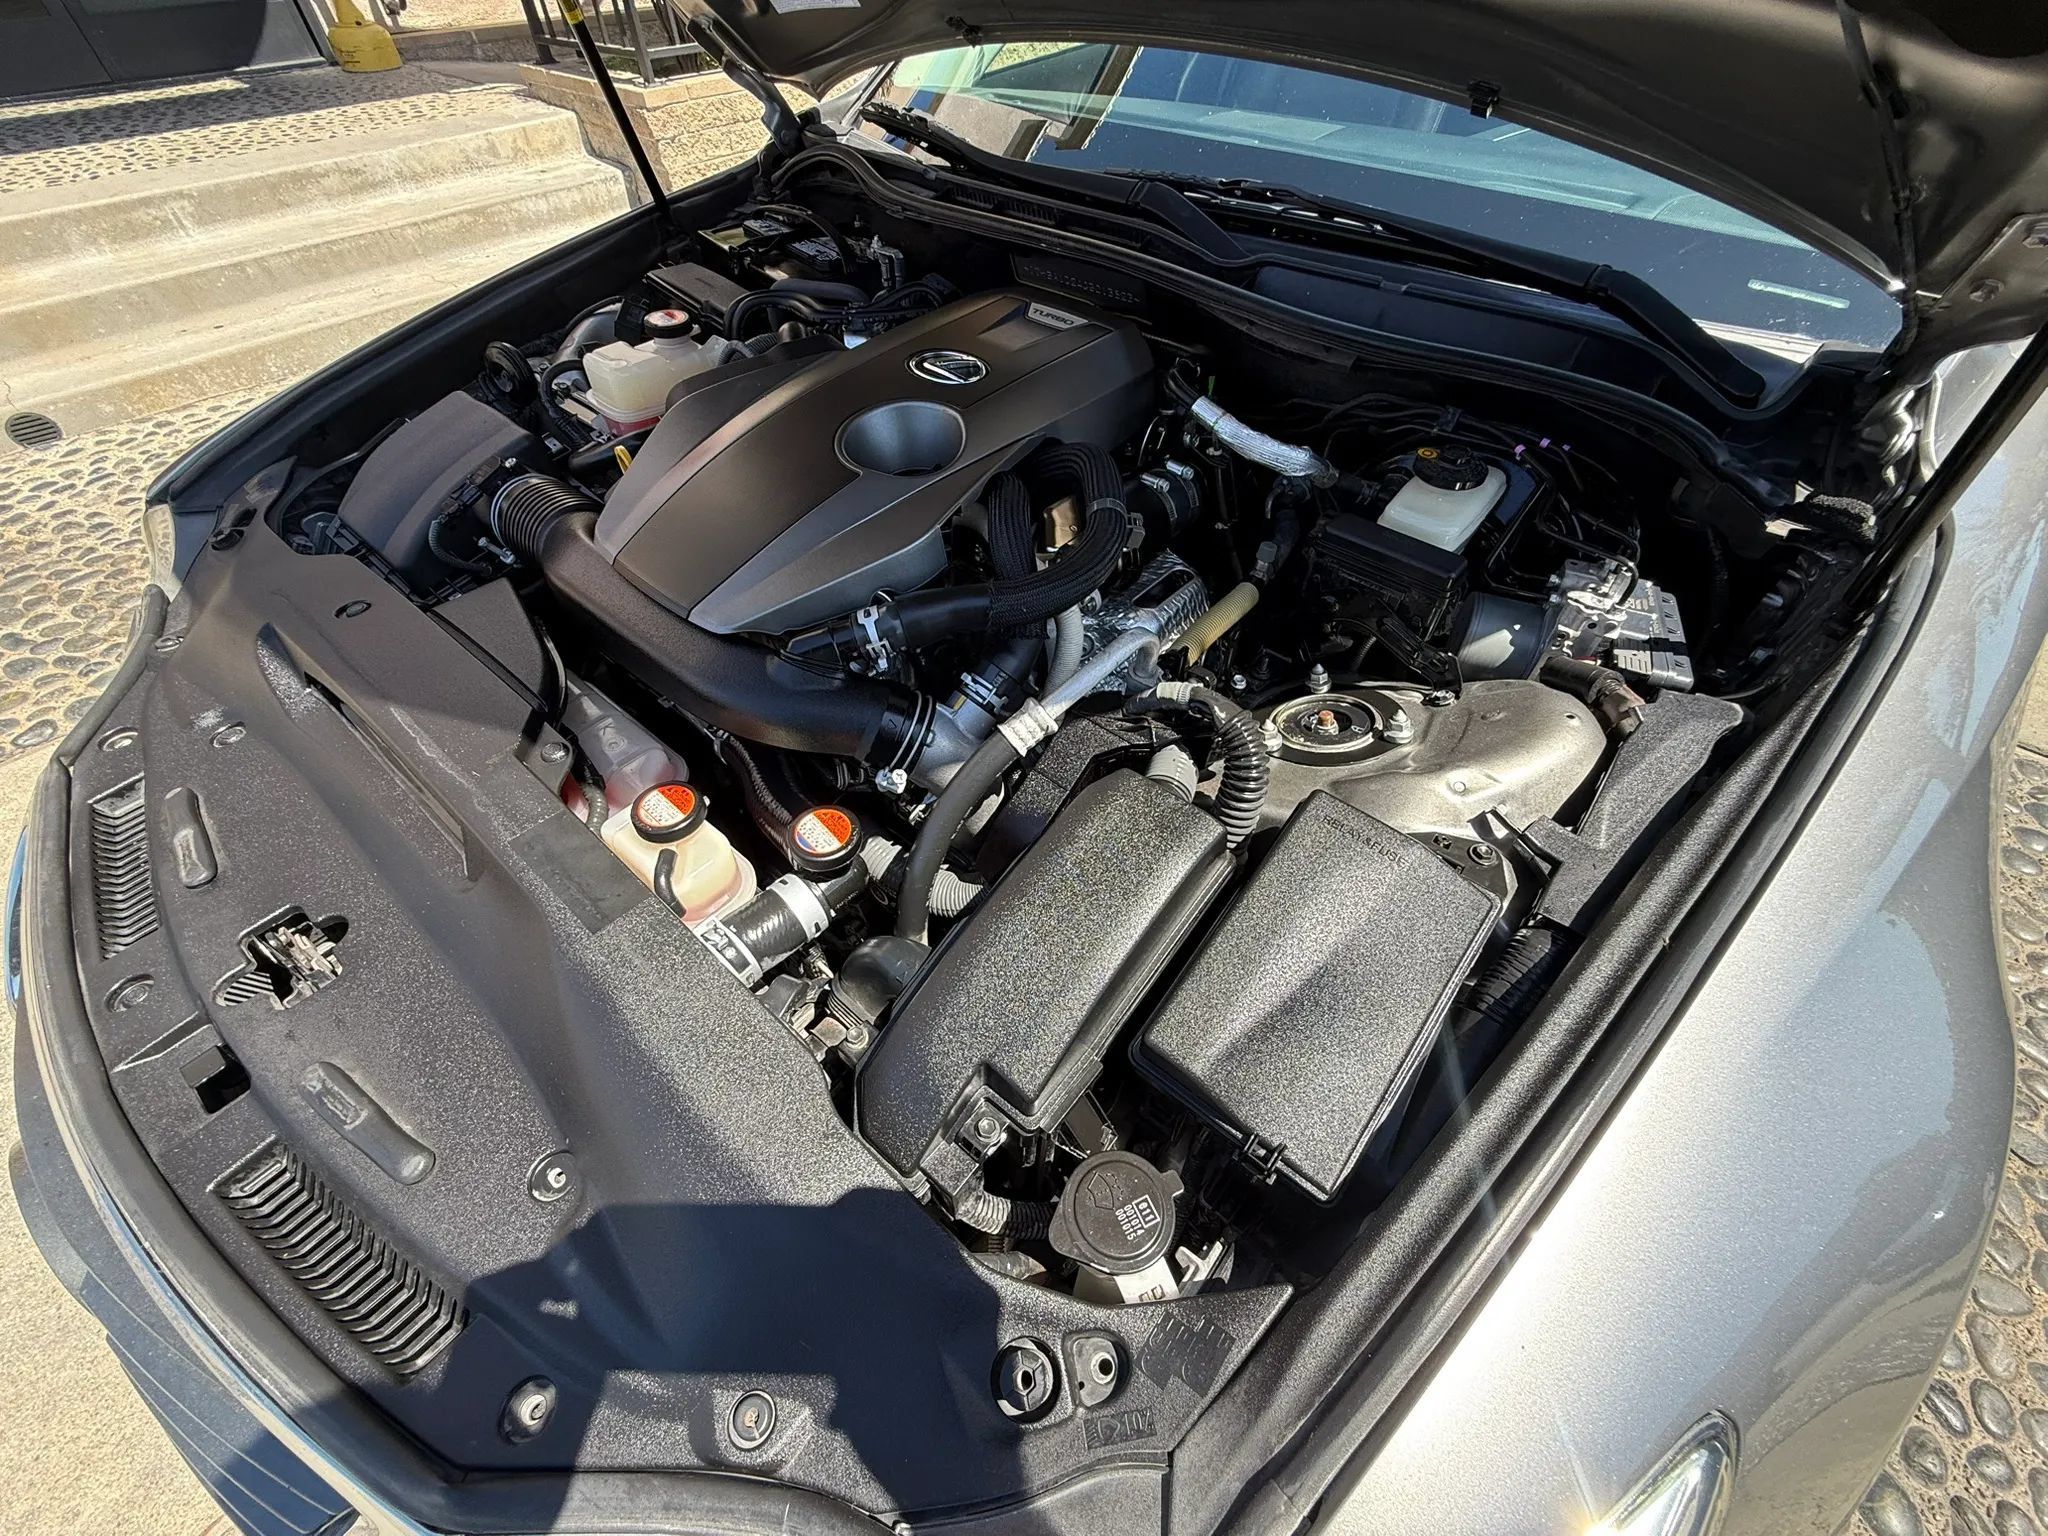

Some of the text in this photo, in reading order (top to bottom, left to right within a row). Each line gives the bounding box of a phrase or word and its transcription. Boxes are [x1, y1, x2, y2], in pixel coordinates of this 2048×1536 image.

[1033, 307, 1074, 326] TURBO
[1115, 1208, 1137, 1241] 001015
[1123, 1204, 1145, 1236] 001014
